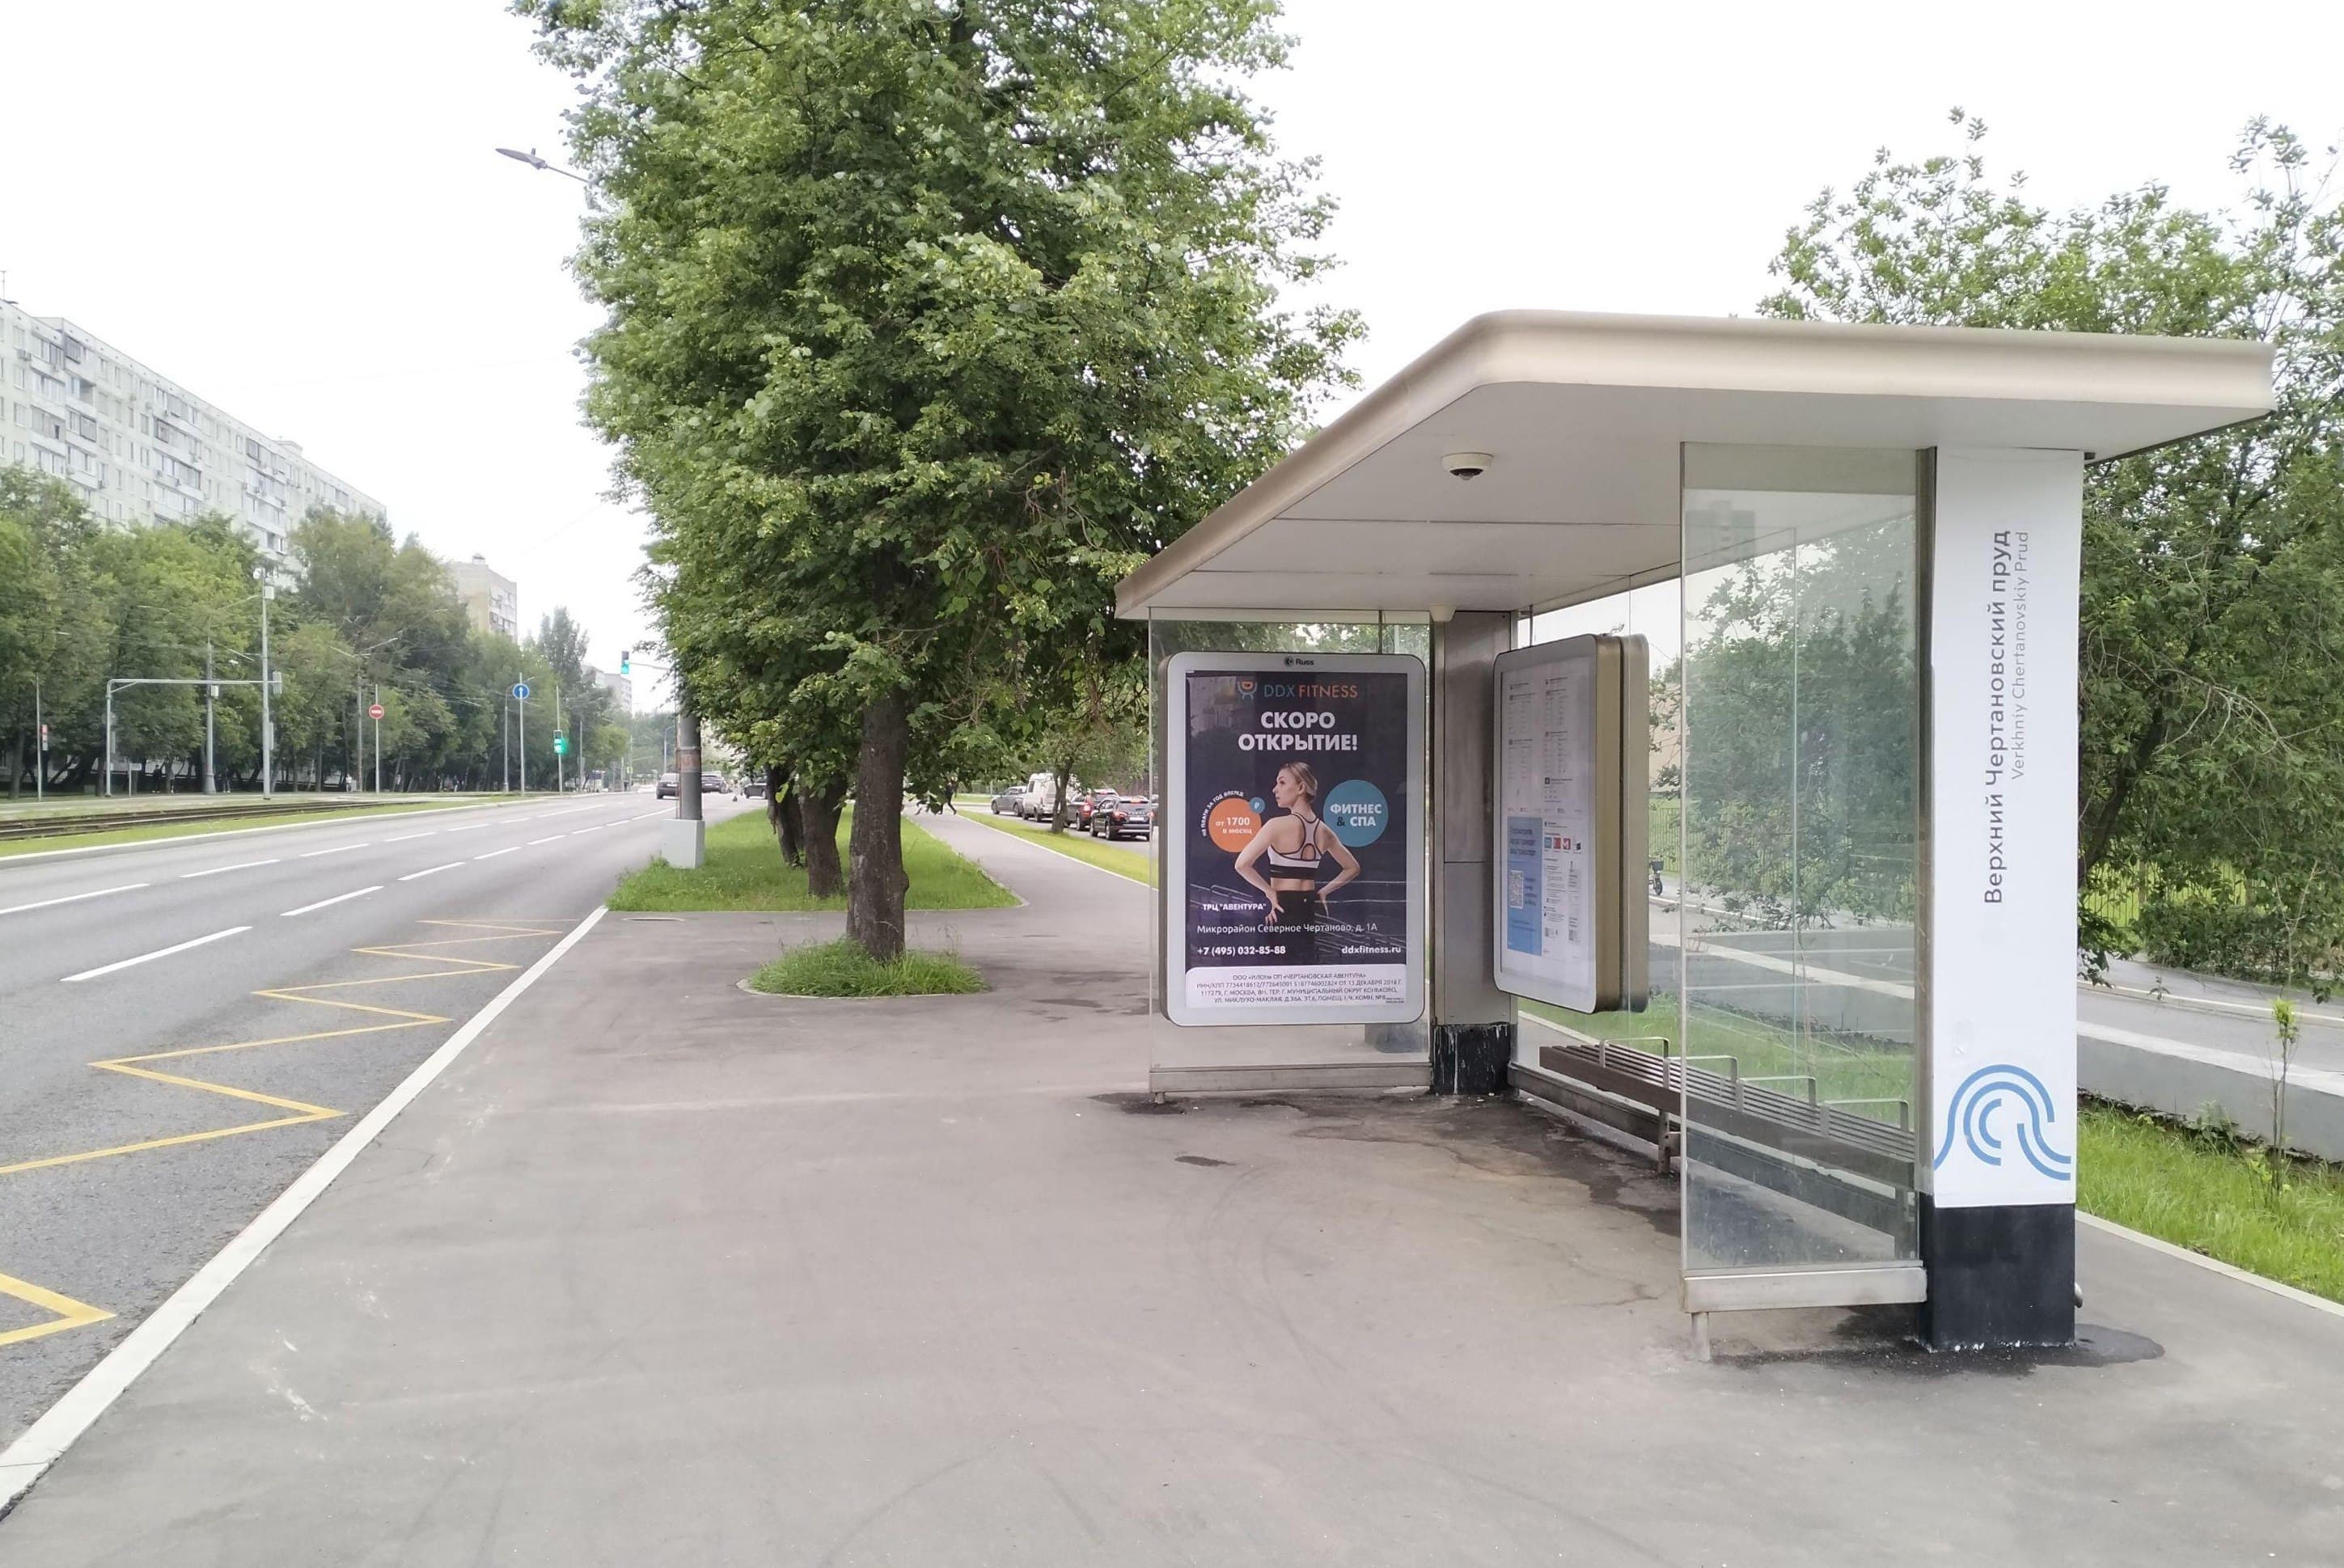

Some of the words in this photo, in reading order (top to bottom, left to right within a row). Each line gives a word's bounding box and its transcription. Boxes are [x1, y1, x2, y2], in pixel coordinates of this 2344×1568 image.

[2014, 531, 2029, 573] Prud
[1992, 530, 2012, 592] пруд
[2012, 577, 2030, 699] Chertanovskiy
[1263, 684, 1295, 698] DDX
[1299, 685, 1358, 698] FITNESS
[1986, 602, 2008, 785] Чертановский
[1260, 711, 1335, 729] СКОРО
[1238, 733, 1358, 751] ОТКРЫТИЕ!
[2012, 704, 2028, 780] Verkhniy
[1330, 803, 1382, 814] ФИТНЕС
[1226, 817, 1250, 826] 1700
[1336, 816, 1346, 826] &
[1349, 816, 1377, 826] СПА
[1984, 794, 2008, 903] Верхний
[1203, 903, 1220, 911] ТРЦ
[1197, 924, 1255, 934] Микрорайон
[1258, 923, 1301, 933] Северное
[1303, 923, 1354, 933] Чертаново,
[1355, 924, 1364, 932] д.
[1197, 946, 1209, 955] +7
[1212, 946, 1236, 957] (495)
[1238, 945, 1286, 955] 032-85-88
[1341, 945, 1402, 954] ddxfitness.ru
